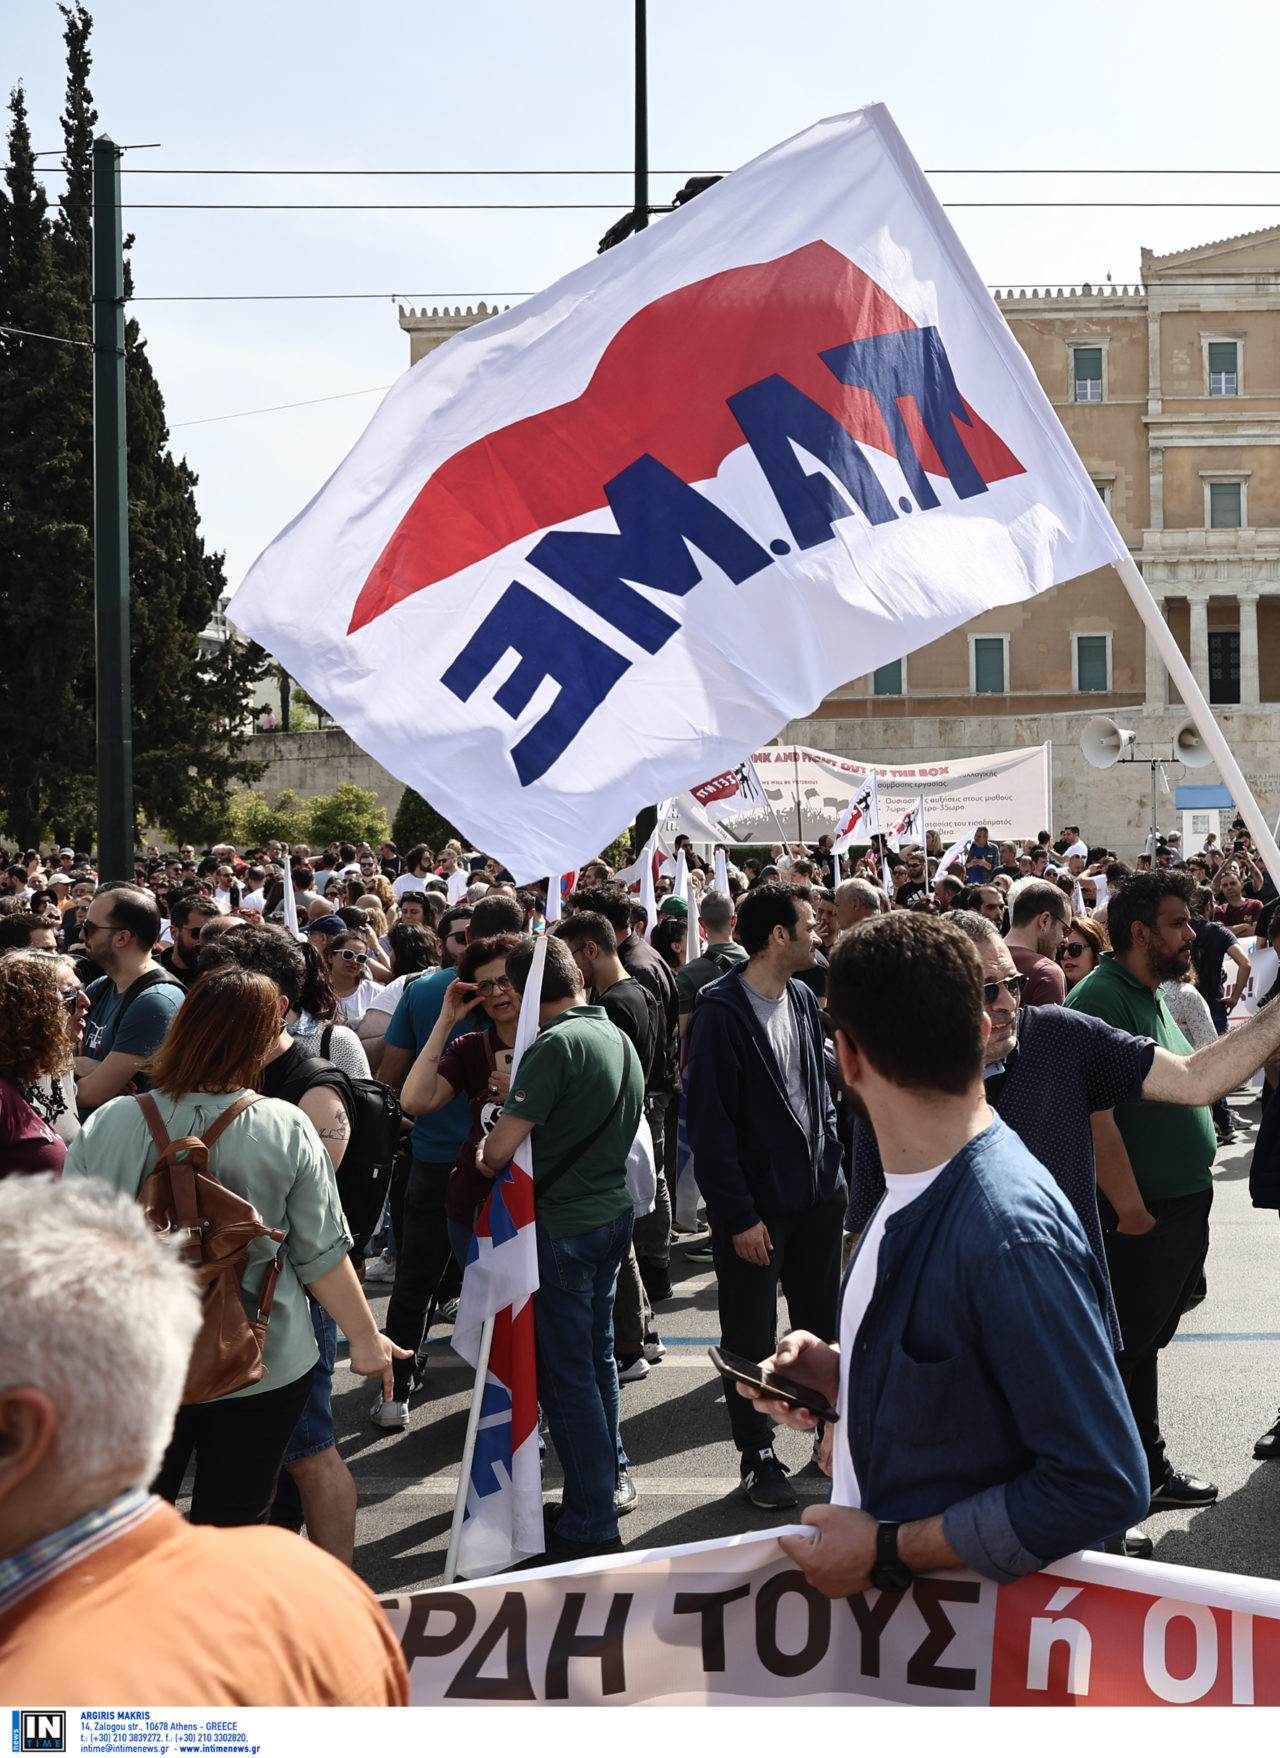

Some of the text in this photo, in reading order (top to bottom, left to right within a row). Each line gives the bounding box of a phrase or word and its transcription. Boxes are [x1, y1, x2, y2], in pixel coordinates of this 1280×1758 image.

[919, 766, 949, 777] BOX
[379, 1592, 634, 1700] ΡΔΗ
[673, 1569, 981, 1690] ΤΟΥΣ
[1026, 1586, 1093, 1696] ή
[1143, 1597, 1255, 1704] ΟΙ
